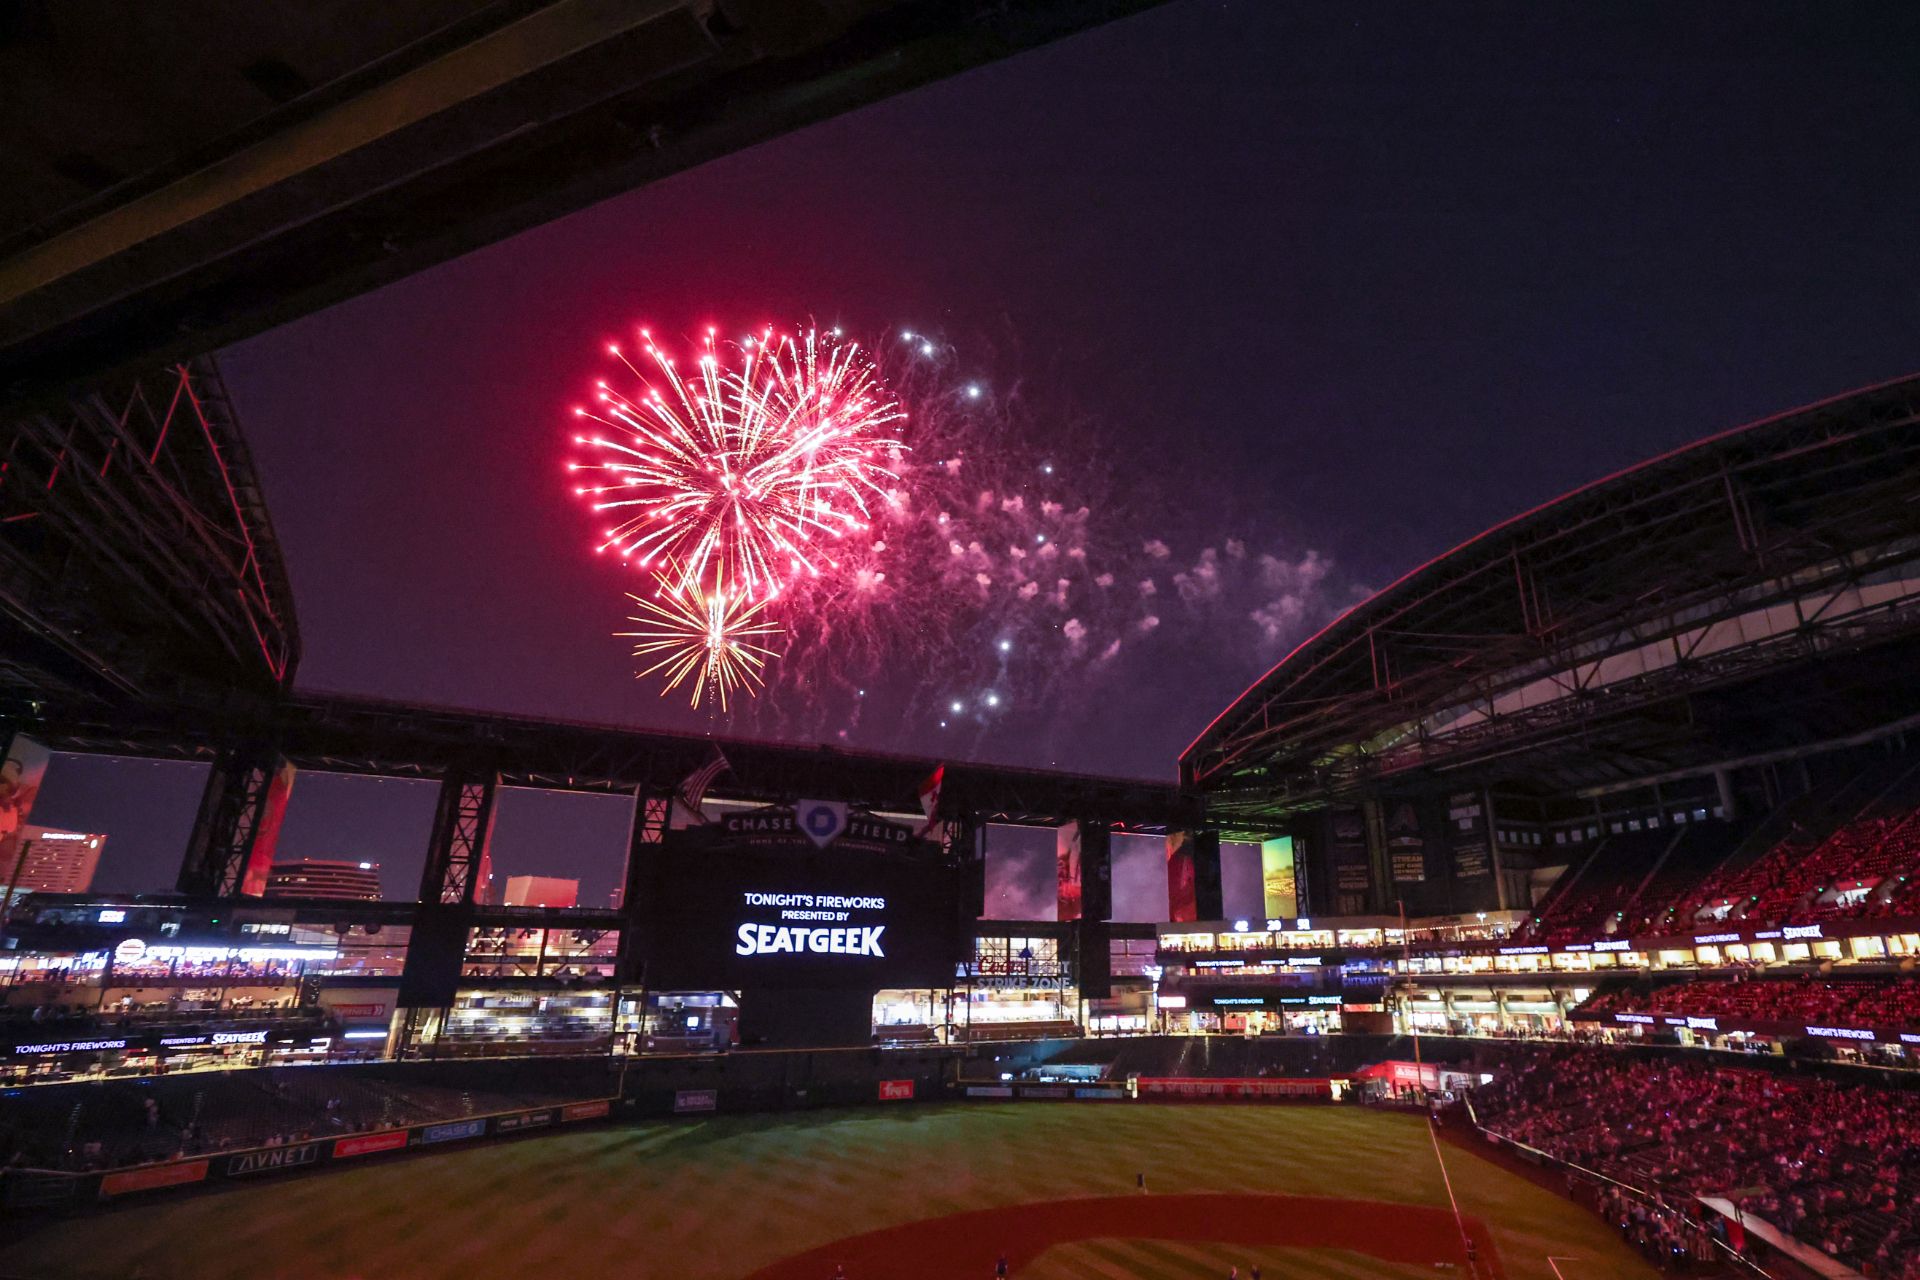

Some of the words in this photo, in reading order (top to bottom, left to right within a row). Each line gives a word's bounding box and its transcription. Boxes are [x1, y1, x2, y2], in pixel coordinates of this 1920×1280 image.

[727, 818, 792, 831] CHASE
[851, 822, 908, 842] FIELD
[743, 892, 813, 907] TONIGHT'S
[816, 895, 885, 910] FIREWORKS
[781, 910, 835, 921] PRESENTED
[837, 912, 850, 921] BY
[1266, 919, 1282, 931] 20
[735, 922, 886, 958] SEATGEEK
[1288, 957, 1322, 966] SEATGEEK
[977, 977, 1027, 990] STRIKE
[1031, 977, 1071, 990] ZONE
[1308, 996, 1343, 1005] SEATGEEK
[211, 1031, 269, 1045] SEATGEEK
[1837, 1028, 1876, 1040] FIREWORKS
[15, 1043, 70, 1054] TONIGHT'S
[71, 1040, 126, 1051] FIREWORKS
[160, 1037, 196, 1045] PRESENTED
